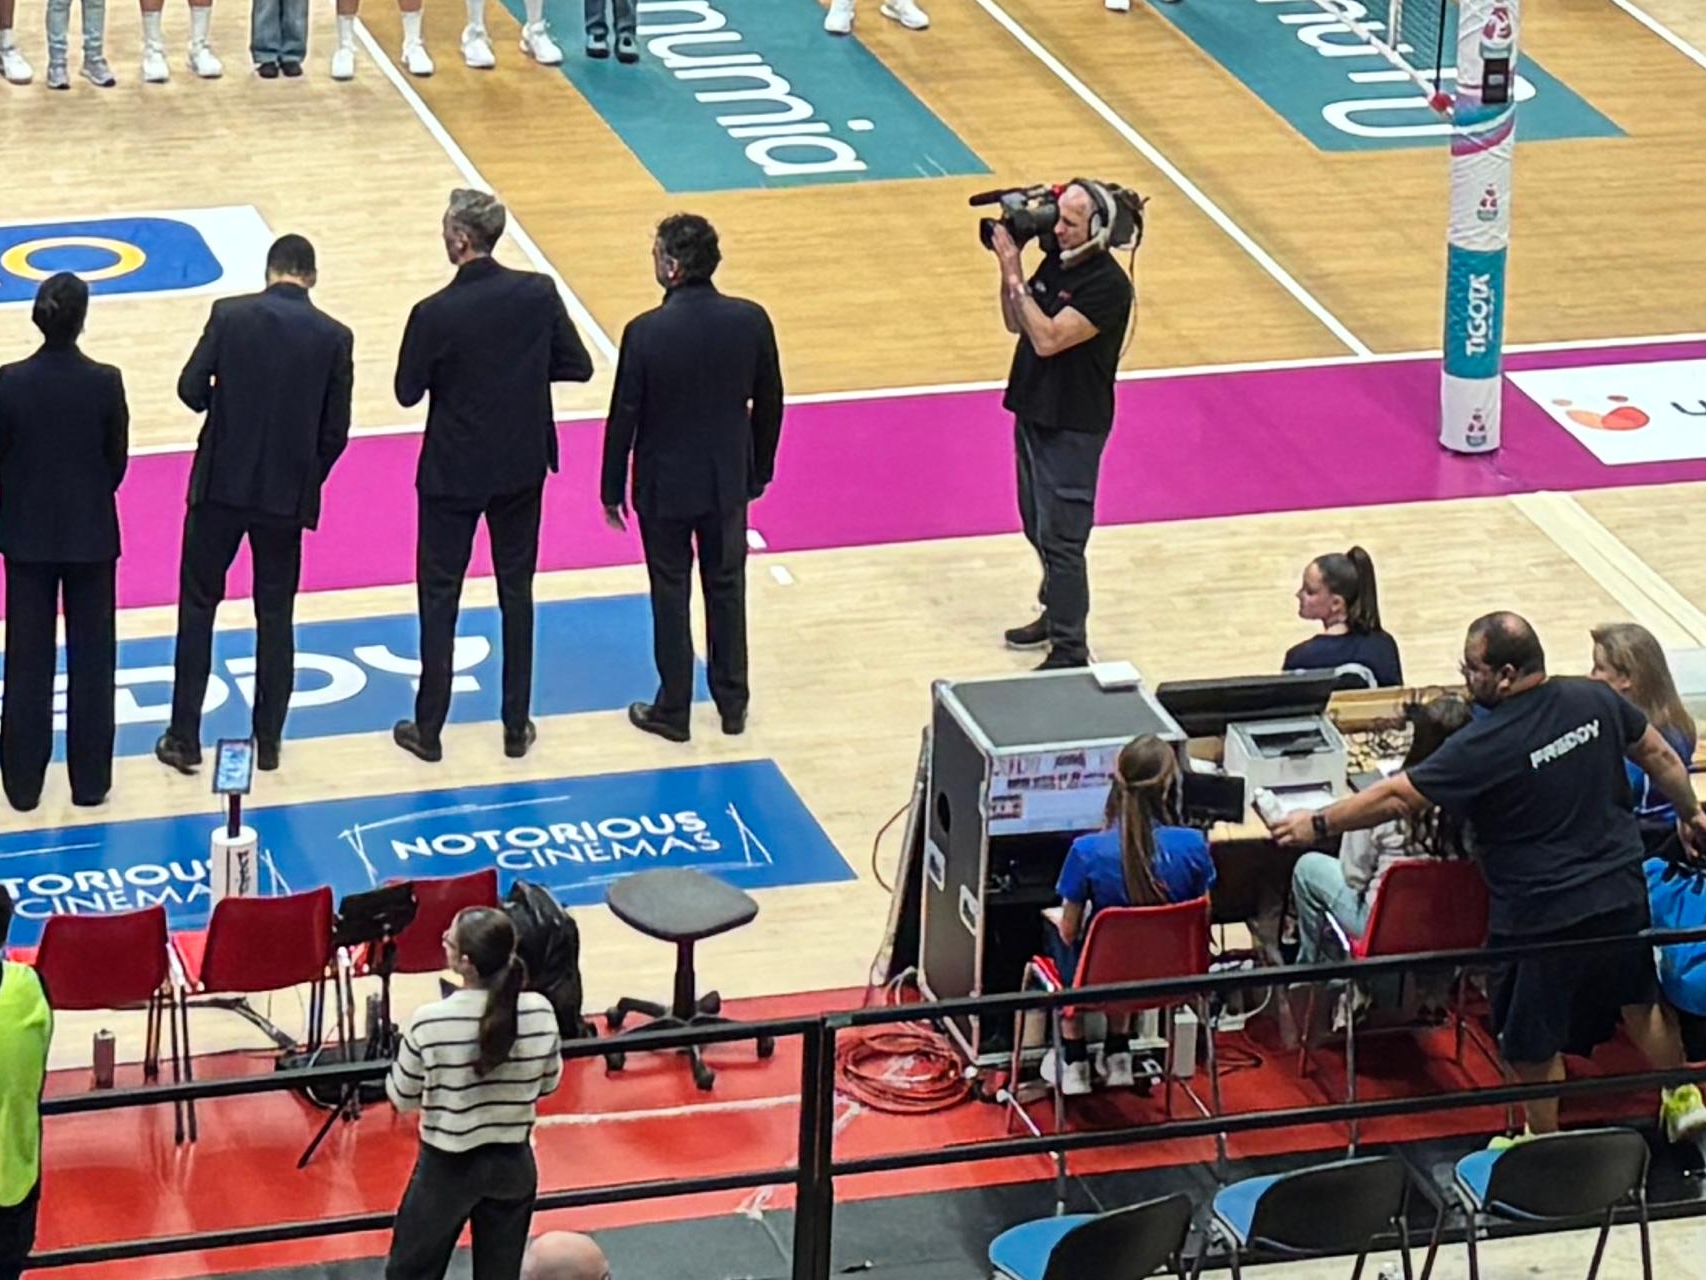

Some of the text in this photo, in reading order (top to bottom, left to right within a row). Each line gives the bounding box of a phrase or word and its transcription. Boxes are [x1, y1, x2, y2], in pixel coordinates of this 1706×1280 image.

[1529, 719, 1601, 770] FREDDY
[392, 811, 707, 861] NOTORIOUS
[495, 830, 722, 872] CINEMAS
[13, 886, 212, 919] CINEMA
